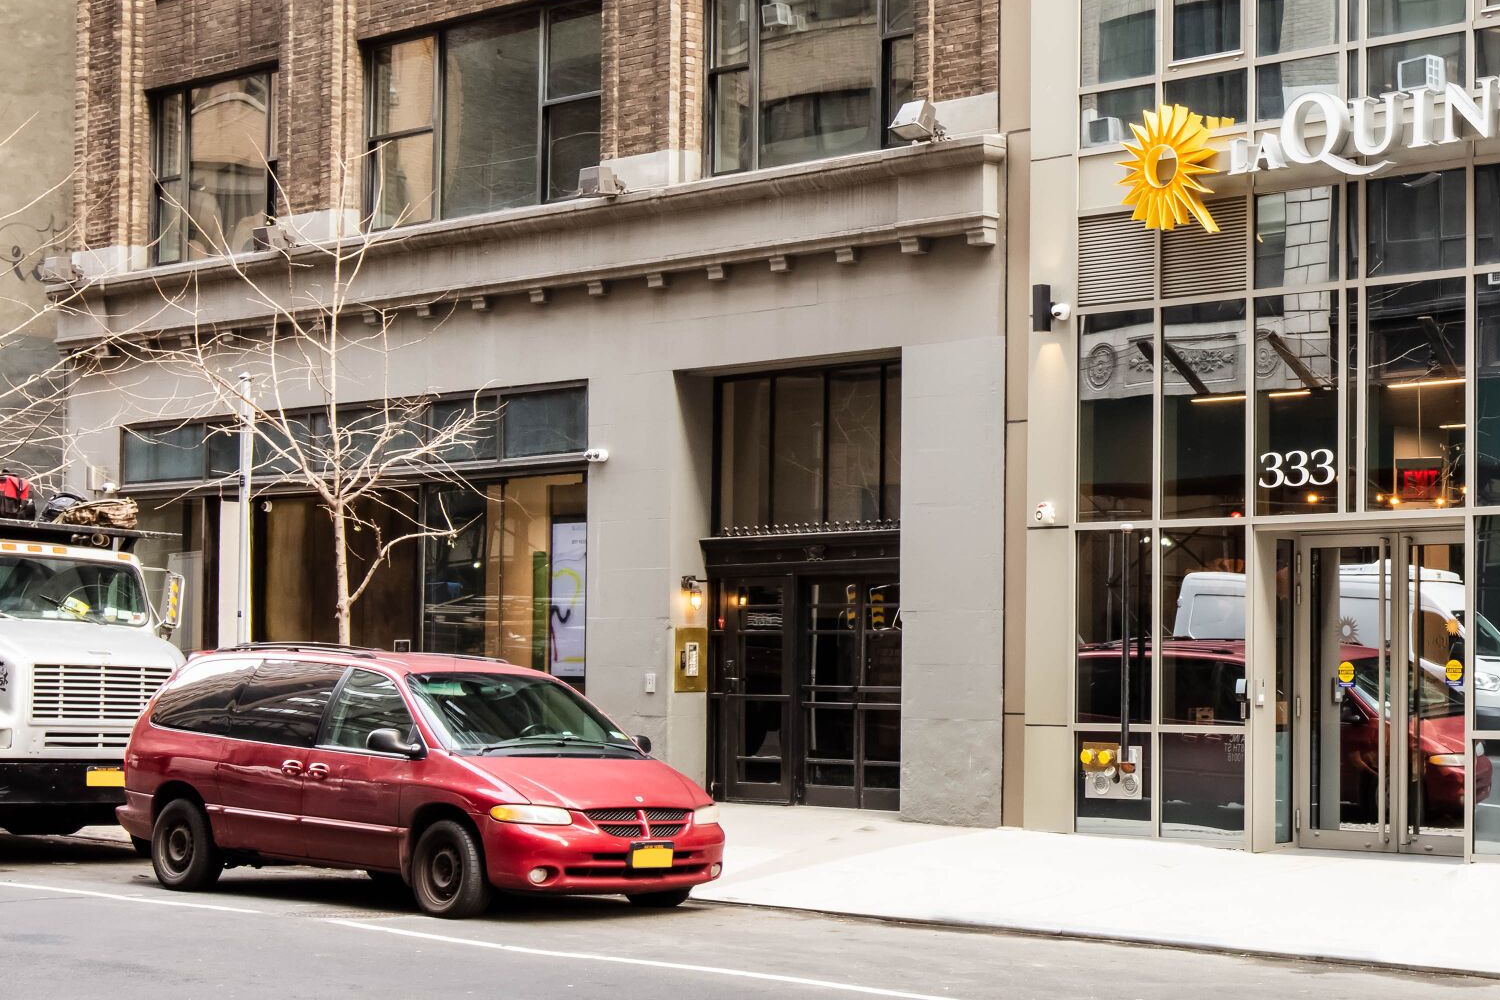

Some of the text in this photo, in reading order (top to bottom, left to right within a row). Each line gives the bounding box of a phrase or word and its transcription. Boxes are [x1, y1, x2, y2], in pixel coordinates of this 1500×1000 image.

[1227, 132, 1288, 176] LA
[1258, 449, 1335, 488] 333
[1404, 470, 1438, 498] EXIT
